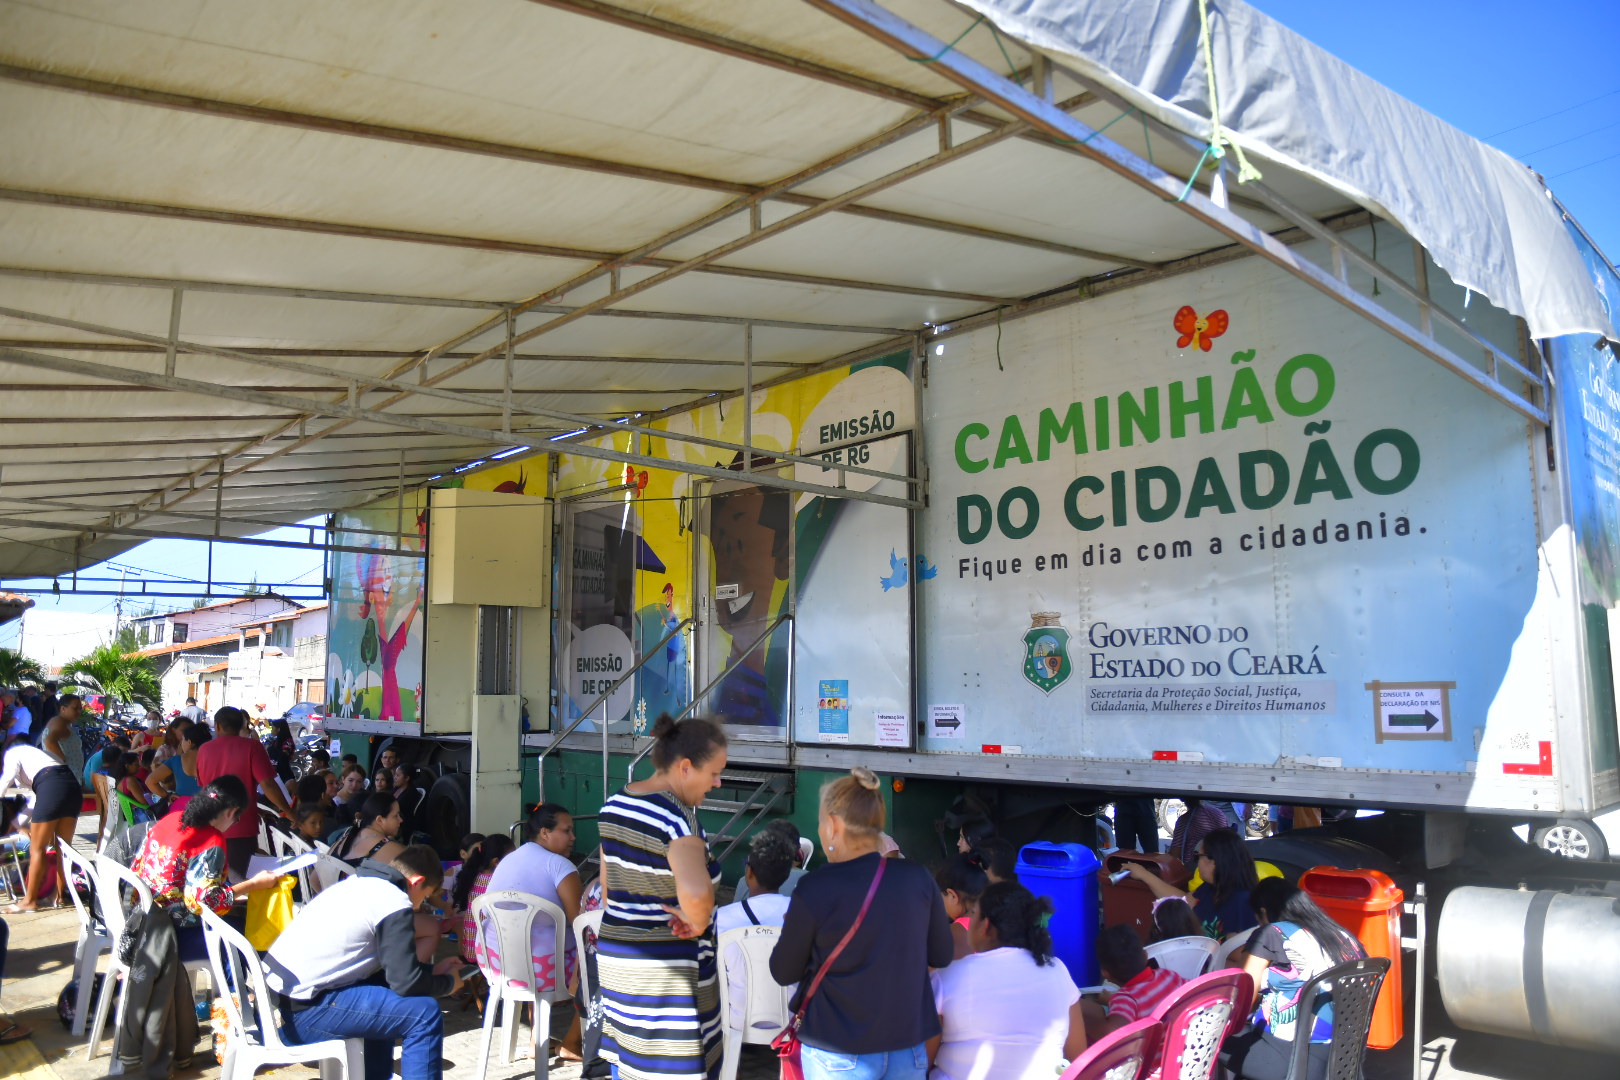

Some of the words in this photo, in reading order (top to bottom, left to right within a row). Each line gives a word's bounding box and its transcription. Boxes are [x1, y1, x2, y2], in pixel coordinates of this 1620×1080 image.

[954, 349, 1335, 473] CAMINHÃO
[820, 410, 895, 444] EMISSÃO
[848, 445, 870, 466] RG
[956, 486, 1040, 545] DO
[1063, 420, 1421, 531] CIDADÃO
[959, 557, 1022, 581] Fique
[1035, 553, 1068, 571] em
[1082, 543, 1121, 566] dia
[1137, 540, 1192, 561] com
[1209, 536, 1222, 554] a
[1240, 512, 1427, 551] cidadania.
[1089, 622, 1211, 648] GOVERNO
[1218, 626, 1248, 643] DO
[576, 653, 622, 672] EMISSÃO
[1089, 653, 1185, 679] ESTADO
[1191, 660, 1221, 677] DO
[1228, 645, 1326, 677] CEARÁ
[582, 679, 596, 695] DE
[1090, 687, 1143, 698] Secretaria
[1145, 686, 1159, 698] da
[1162, 687, 1211, 700] Proteção
[1214, 685, 1253, 698] Social,
[1255, 685, 1301, 699] Justiça,
[1091, 700, 1148, 712] Cidadania,
[1151, 700, 1202, 711] Mulheres
[1205, 702, 1212, 711] e
[1214, 699, 1262, 711] Direitos
[1264, 699, 1326, 711] Humanos
